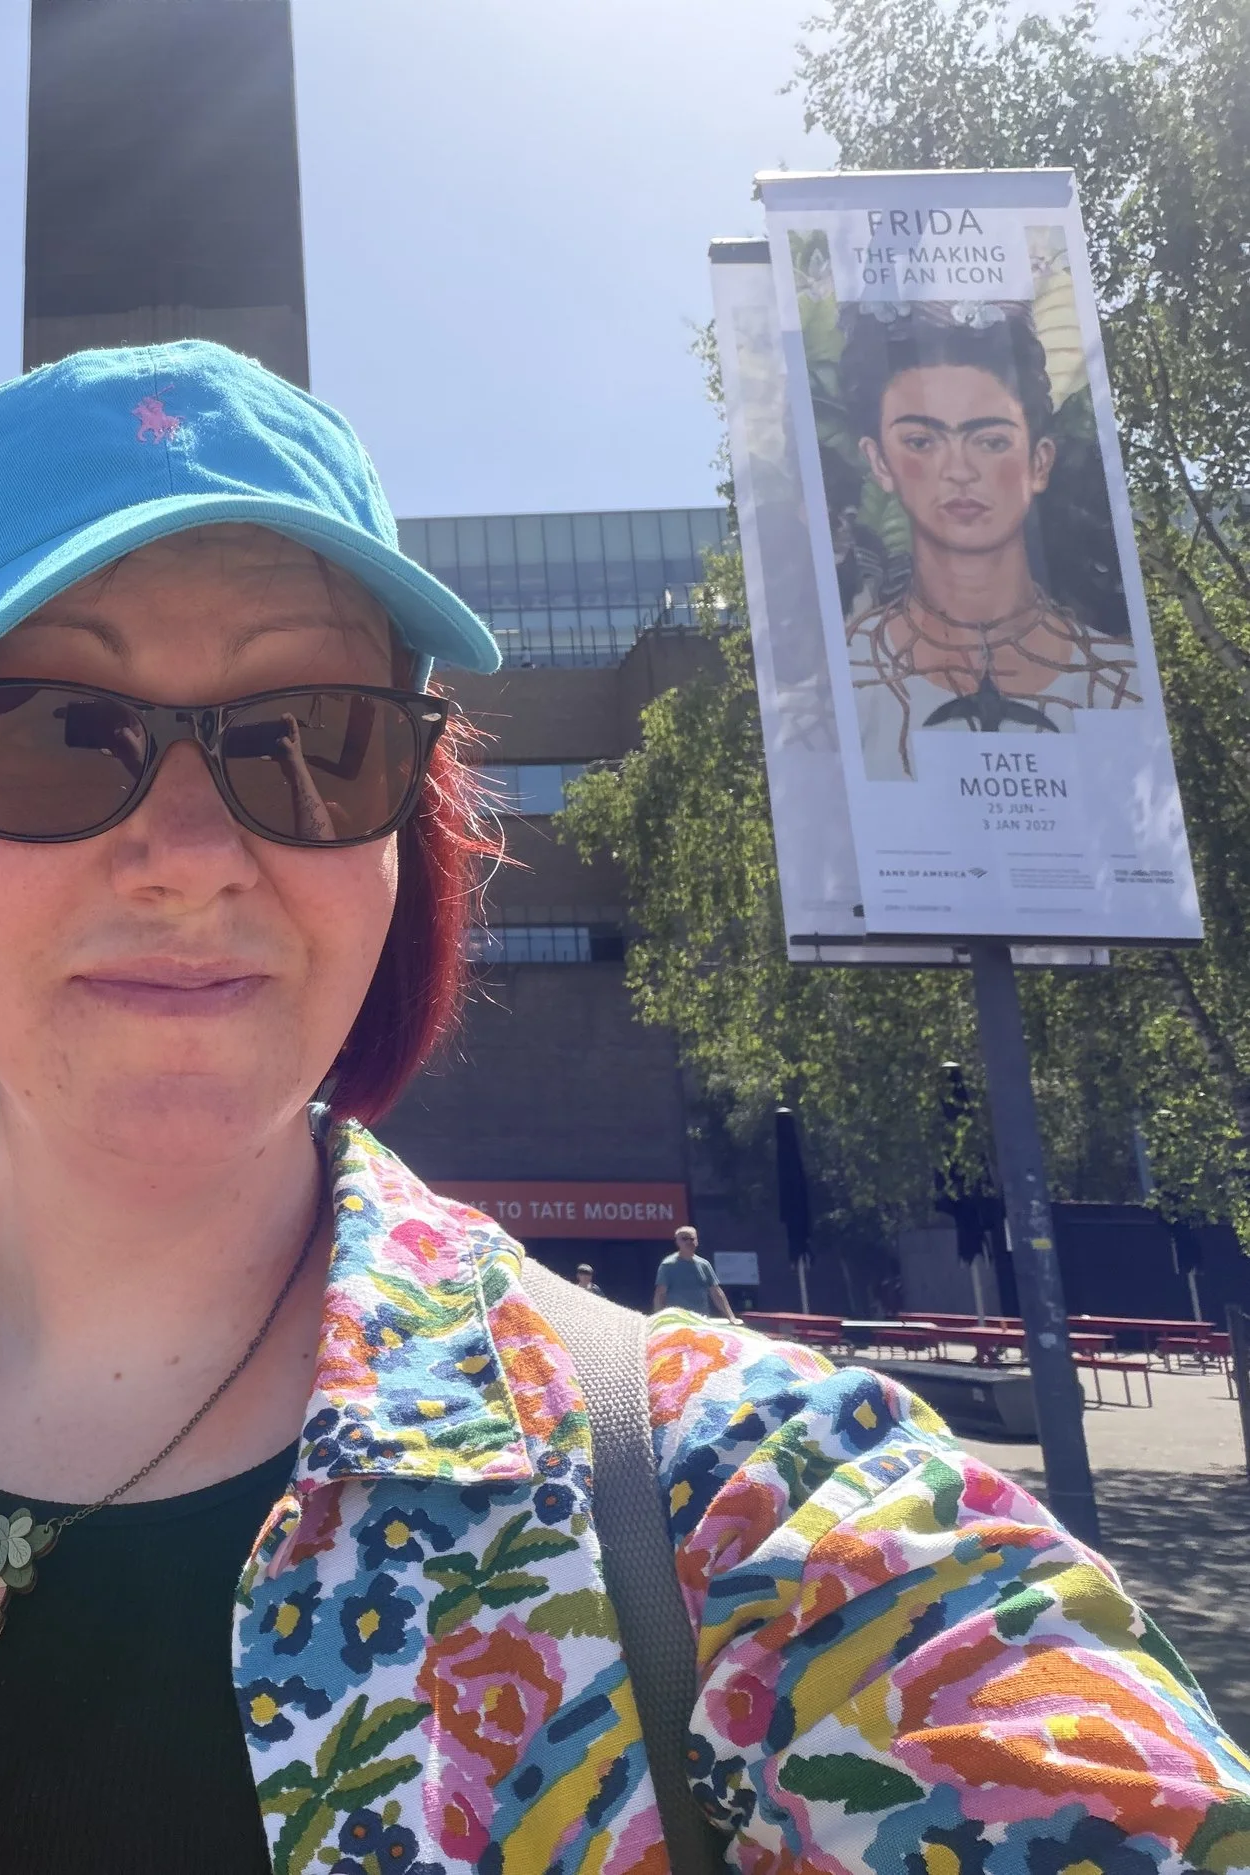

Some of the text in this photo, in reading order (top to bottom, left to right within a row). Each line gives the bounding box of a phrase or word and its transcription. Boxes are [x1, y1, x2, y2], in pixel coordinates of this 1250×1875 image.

[866, 208, 983, 236] FRIDA
[853, 245, 1006, 264] THE MAKING
[862, 267, 1004, 285] OF AN ICON
[980, 752, 1039, 773] TATE
[959, 777, 1068, 798] MODERN
[1008, 803, 1034, 814] JUN
[982, 819, 1057, 832] 3 JAN 2027
[496, 1200, 522, 1220] TO
[529, 1201, 576, 1220] TATE
[584, 1202, 674, 1221] MODERN
